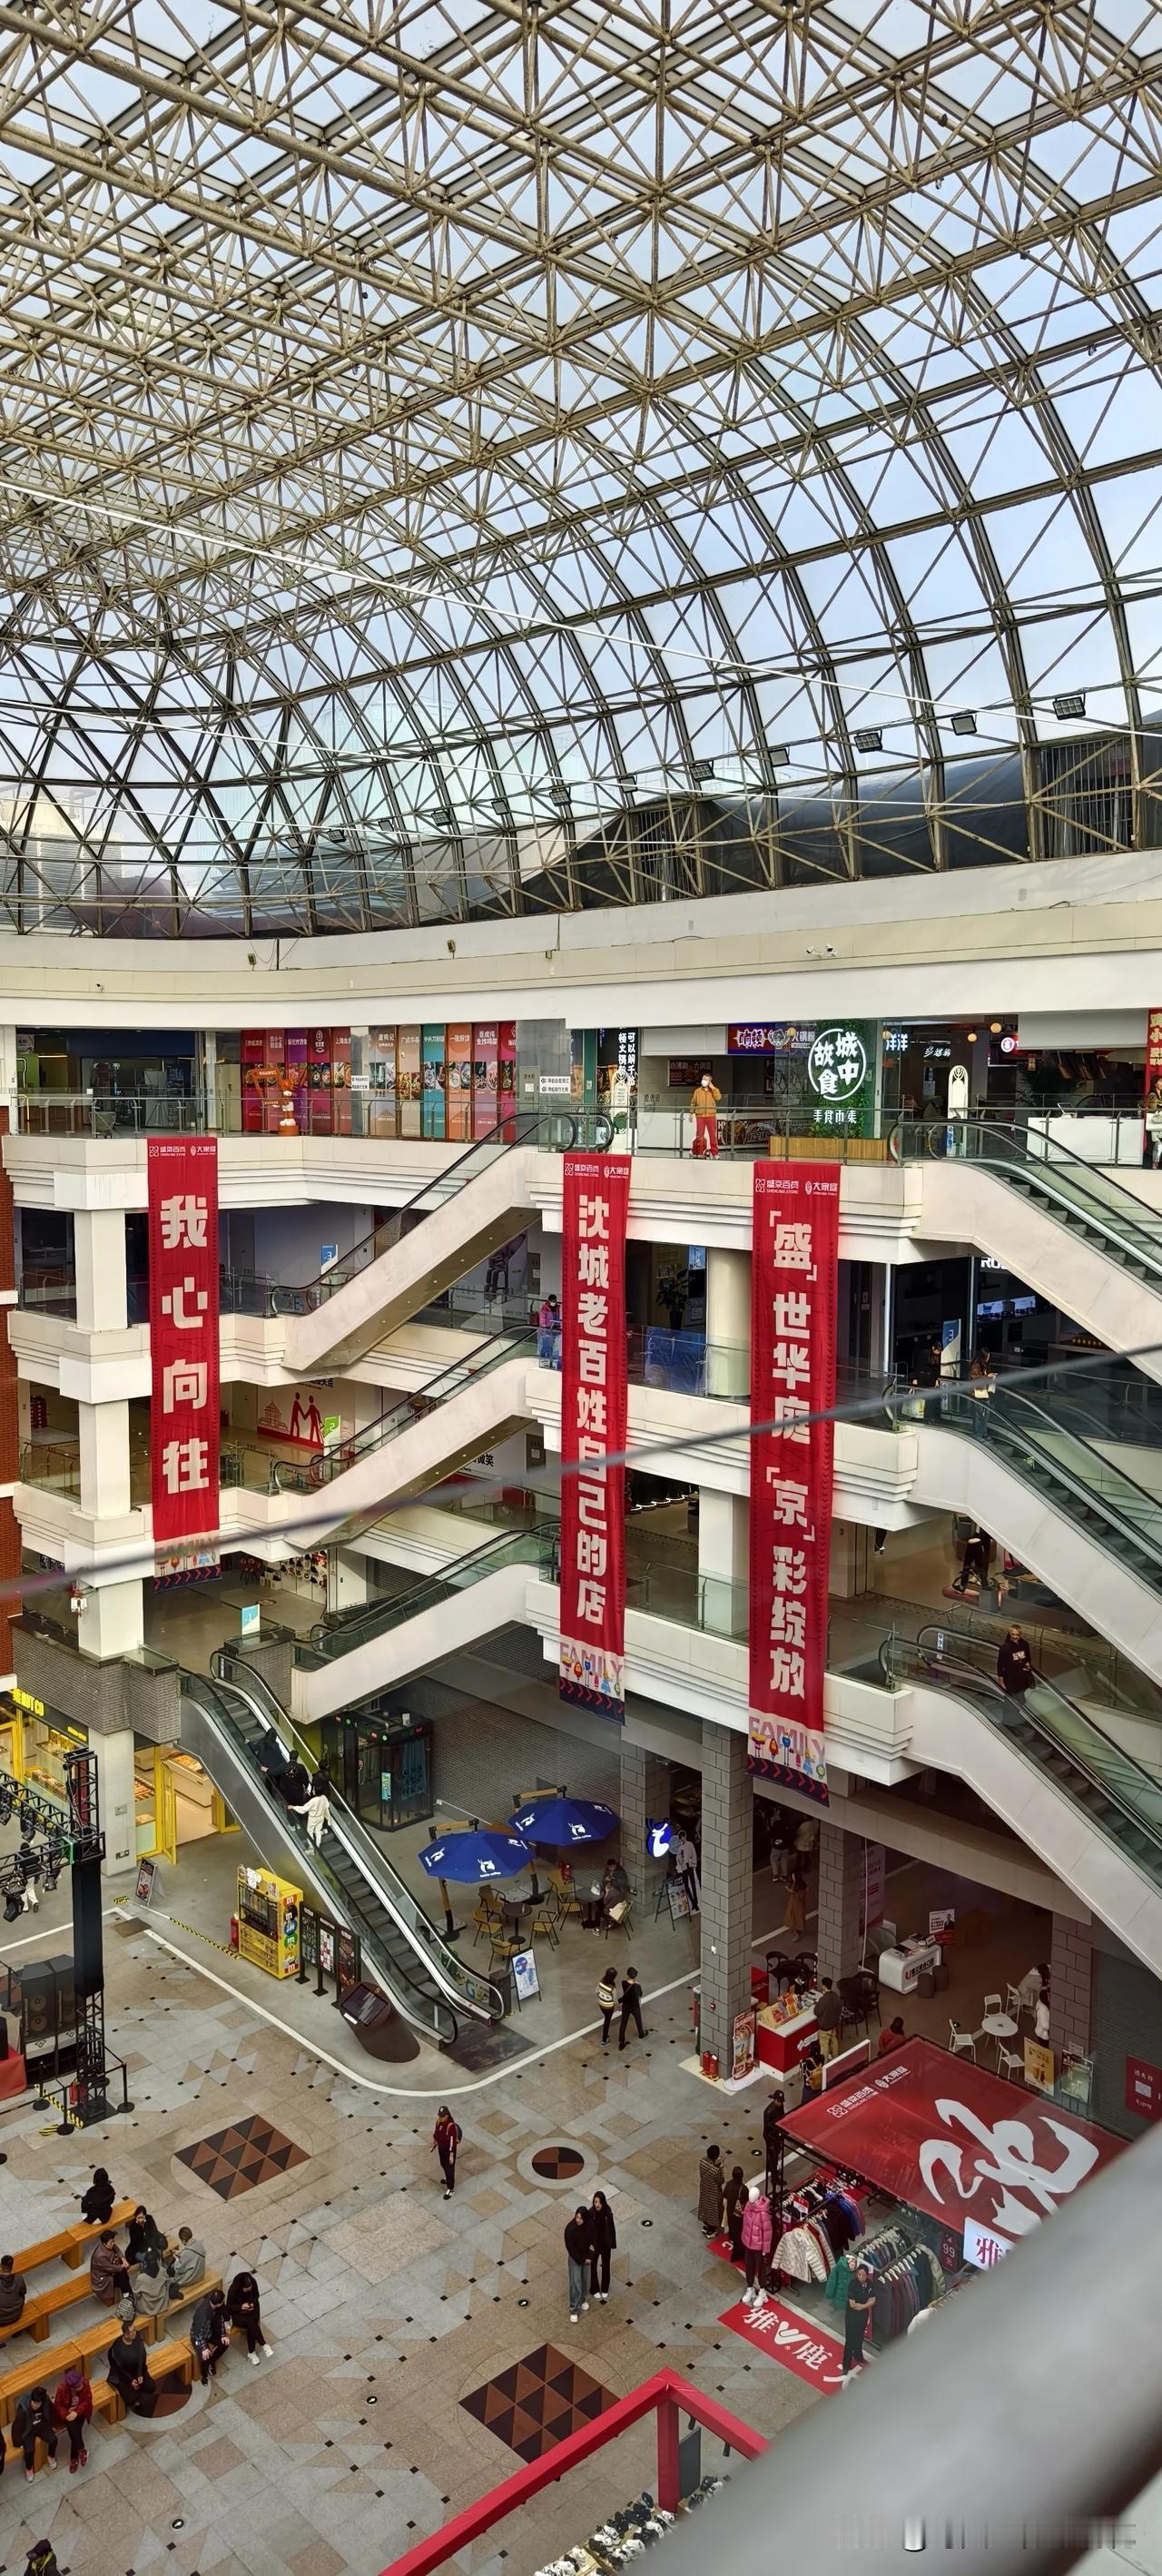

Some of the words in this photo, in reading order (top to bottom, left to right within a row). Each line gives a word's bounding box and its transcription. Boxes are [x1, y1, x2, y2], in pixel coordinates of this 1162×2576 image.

[161, 1195, 209, 1494] 我心向往
[576, 1195, 610, 1625] 沈城老百姓自己的店
[943, 2243, 955, 2258] 99
